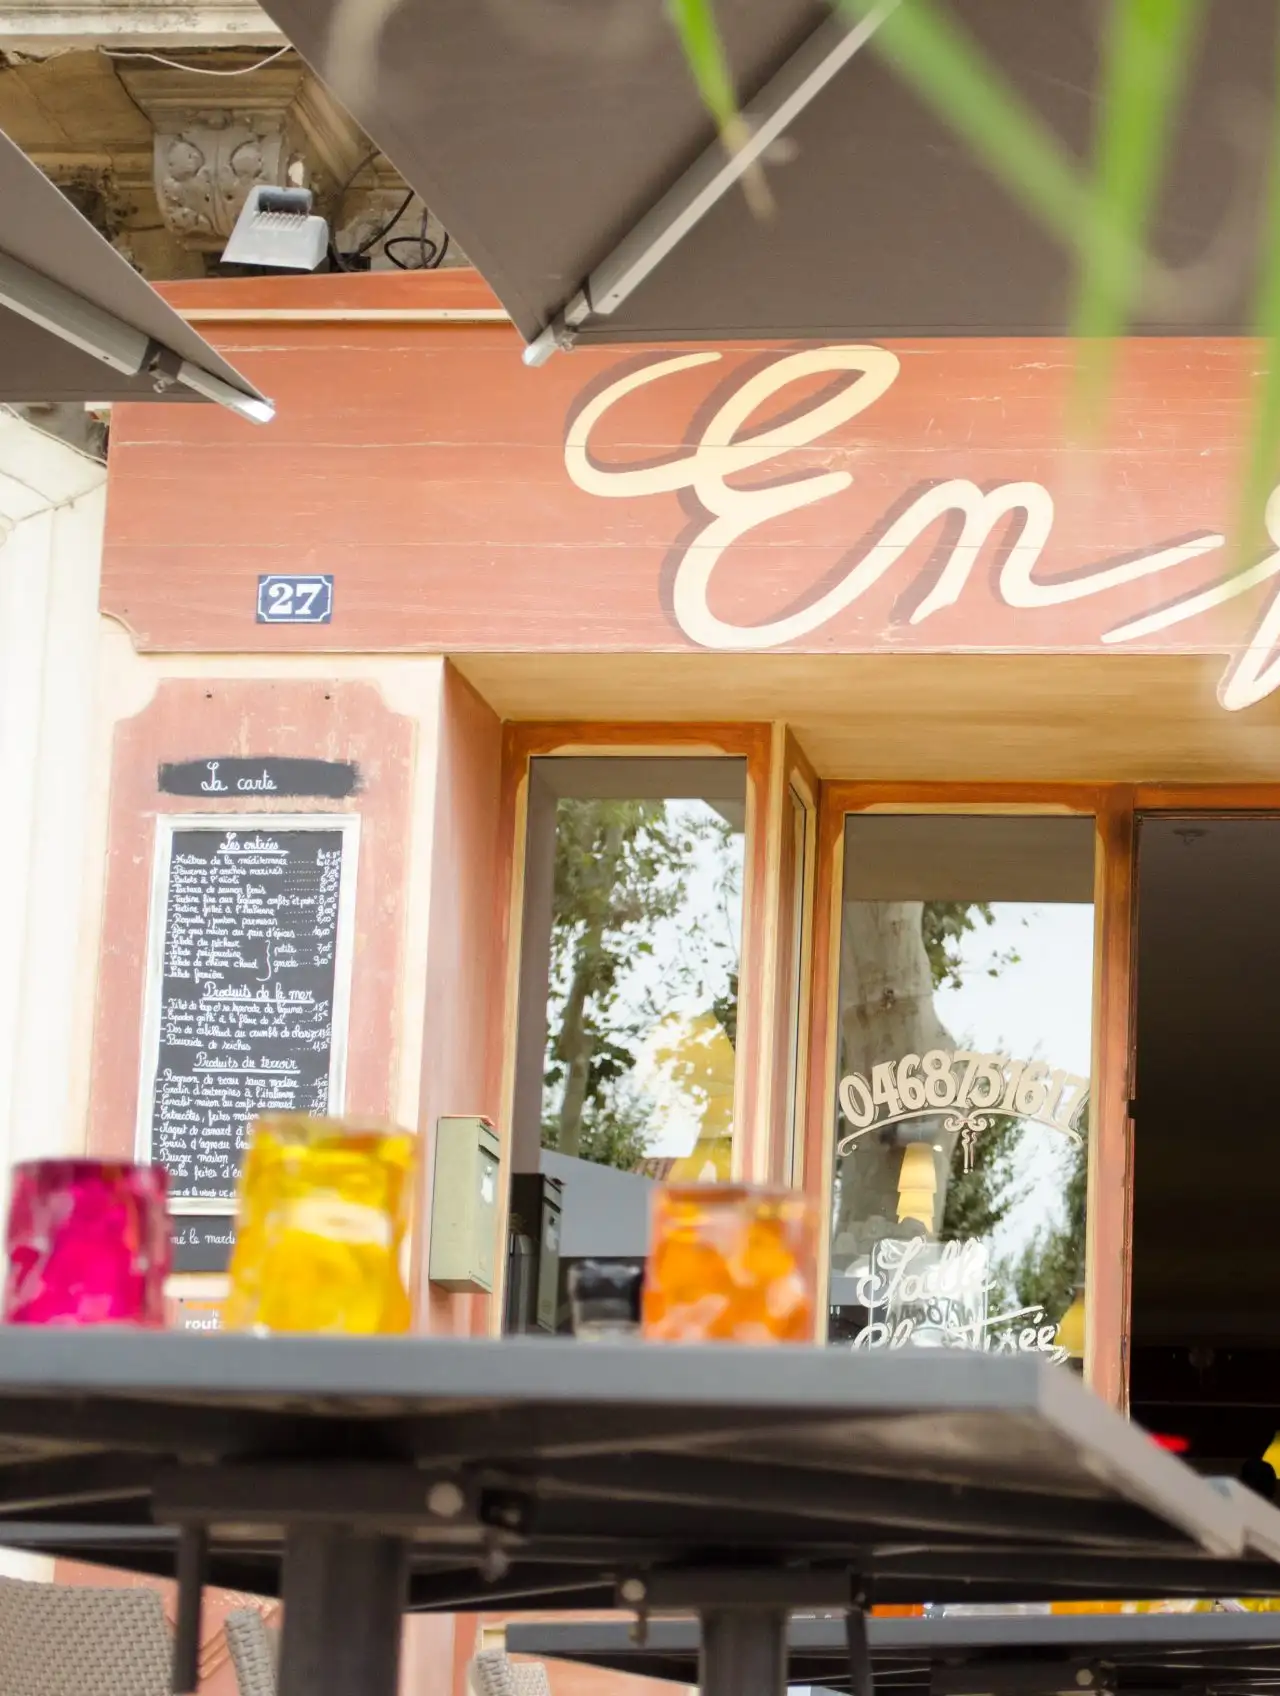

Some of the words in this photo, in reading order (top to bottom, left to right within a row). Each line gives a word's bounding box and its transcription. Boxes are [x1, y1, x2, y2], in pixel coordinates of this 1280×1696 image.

[565, 344, 1225, 648] En
[268, 583, 323, 615] 27
[201, 761, 228, 791] La
[237, 769, 278, 790] carte
[220, 832, 240, 850] Les
[243, 836, 278, 850] entrées
[210, 855, 221, 865] de
[224, 854, 235, 865] la
[210, 867, 219, 875] et
[197, 937, 208, 946] du
[193, 959, 202, 967] de
[233, 958, 258, 969] chaud
[203, 981, 252, 999] Produits
[256, 984, 270, 1000] de
[275, 982, 287, 1001] la
[289, 989, 314, 1001] mer
[188, 1001, 197, 1010] de
[264, 1004, 274, 1013] de
[260, 1016, 269, 1024] de
[166, 1023, 182, 1034] Dos
[184, 1026, 193, 1034] de
[234, 1030, 246, 1038] au
[280, 1026, 290, 1038] de
[208, 1040, 217, 1049] de
[194, 1052, 238, 1068] Produits
[242, 1056, 256, 1068] du
[260, 1055, 297, 1069] terroir
[163, 1069, 200, 1088] Rognon
[203, 1073, 214, 1085] de
[217, 1076, 240, 1085] veau
[244, 1087, 253, 1098] à
[839, 1049, 1089, 1128] 0468751617
[194, 1096, 220, 1107] maison
[257, 1099, 266, 1108] de
[160, 1121, 188, 1140] Magret
[189, 1125, 199, 1135] de
[201, 1124, 232, 1136] canard
[236, 1126, 244, 1136] à
[160, 1134, 187, 1149] Souris
[190, 1137, 230, 1154] d'agneau
[160, 1148, 192, 1166] Burger
[197, 1151, 228, 1165] maison
[189, 1228, 200, 1244] le
